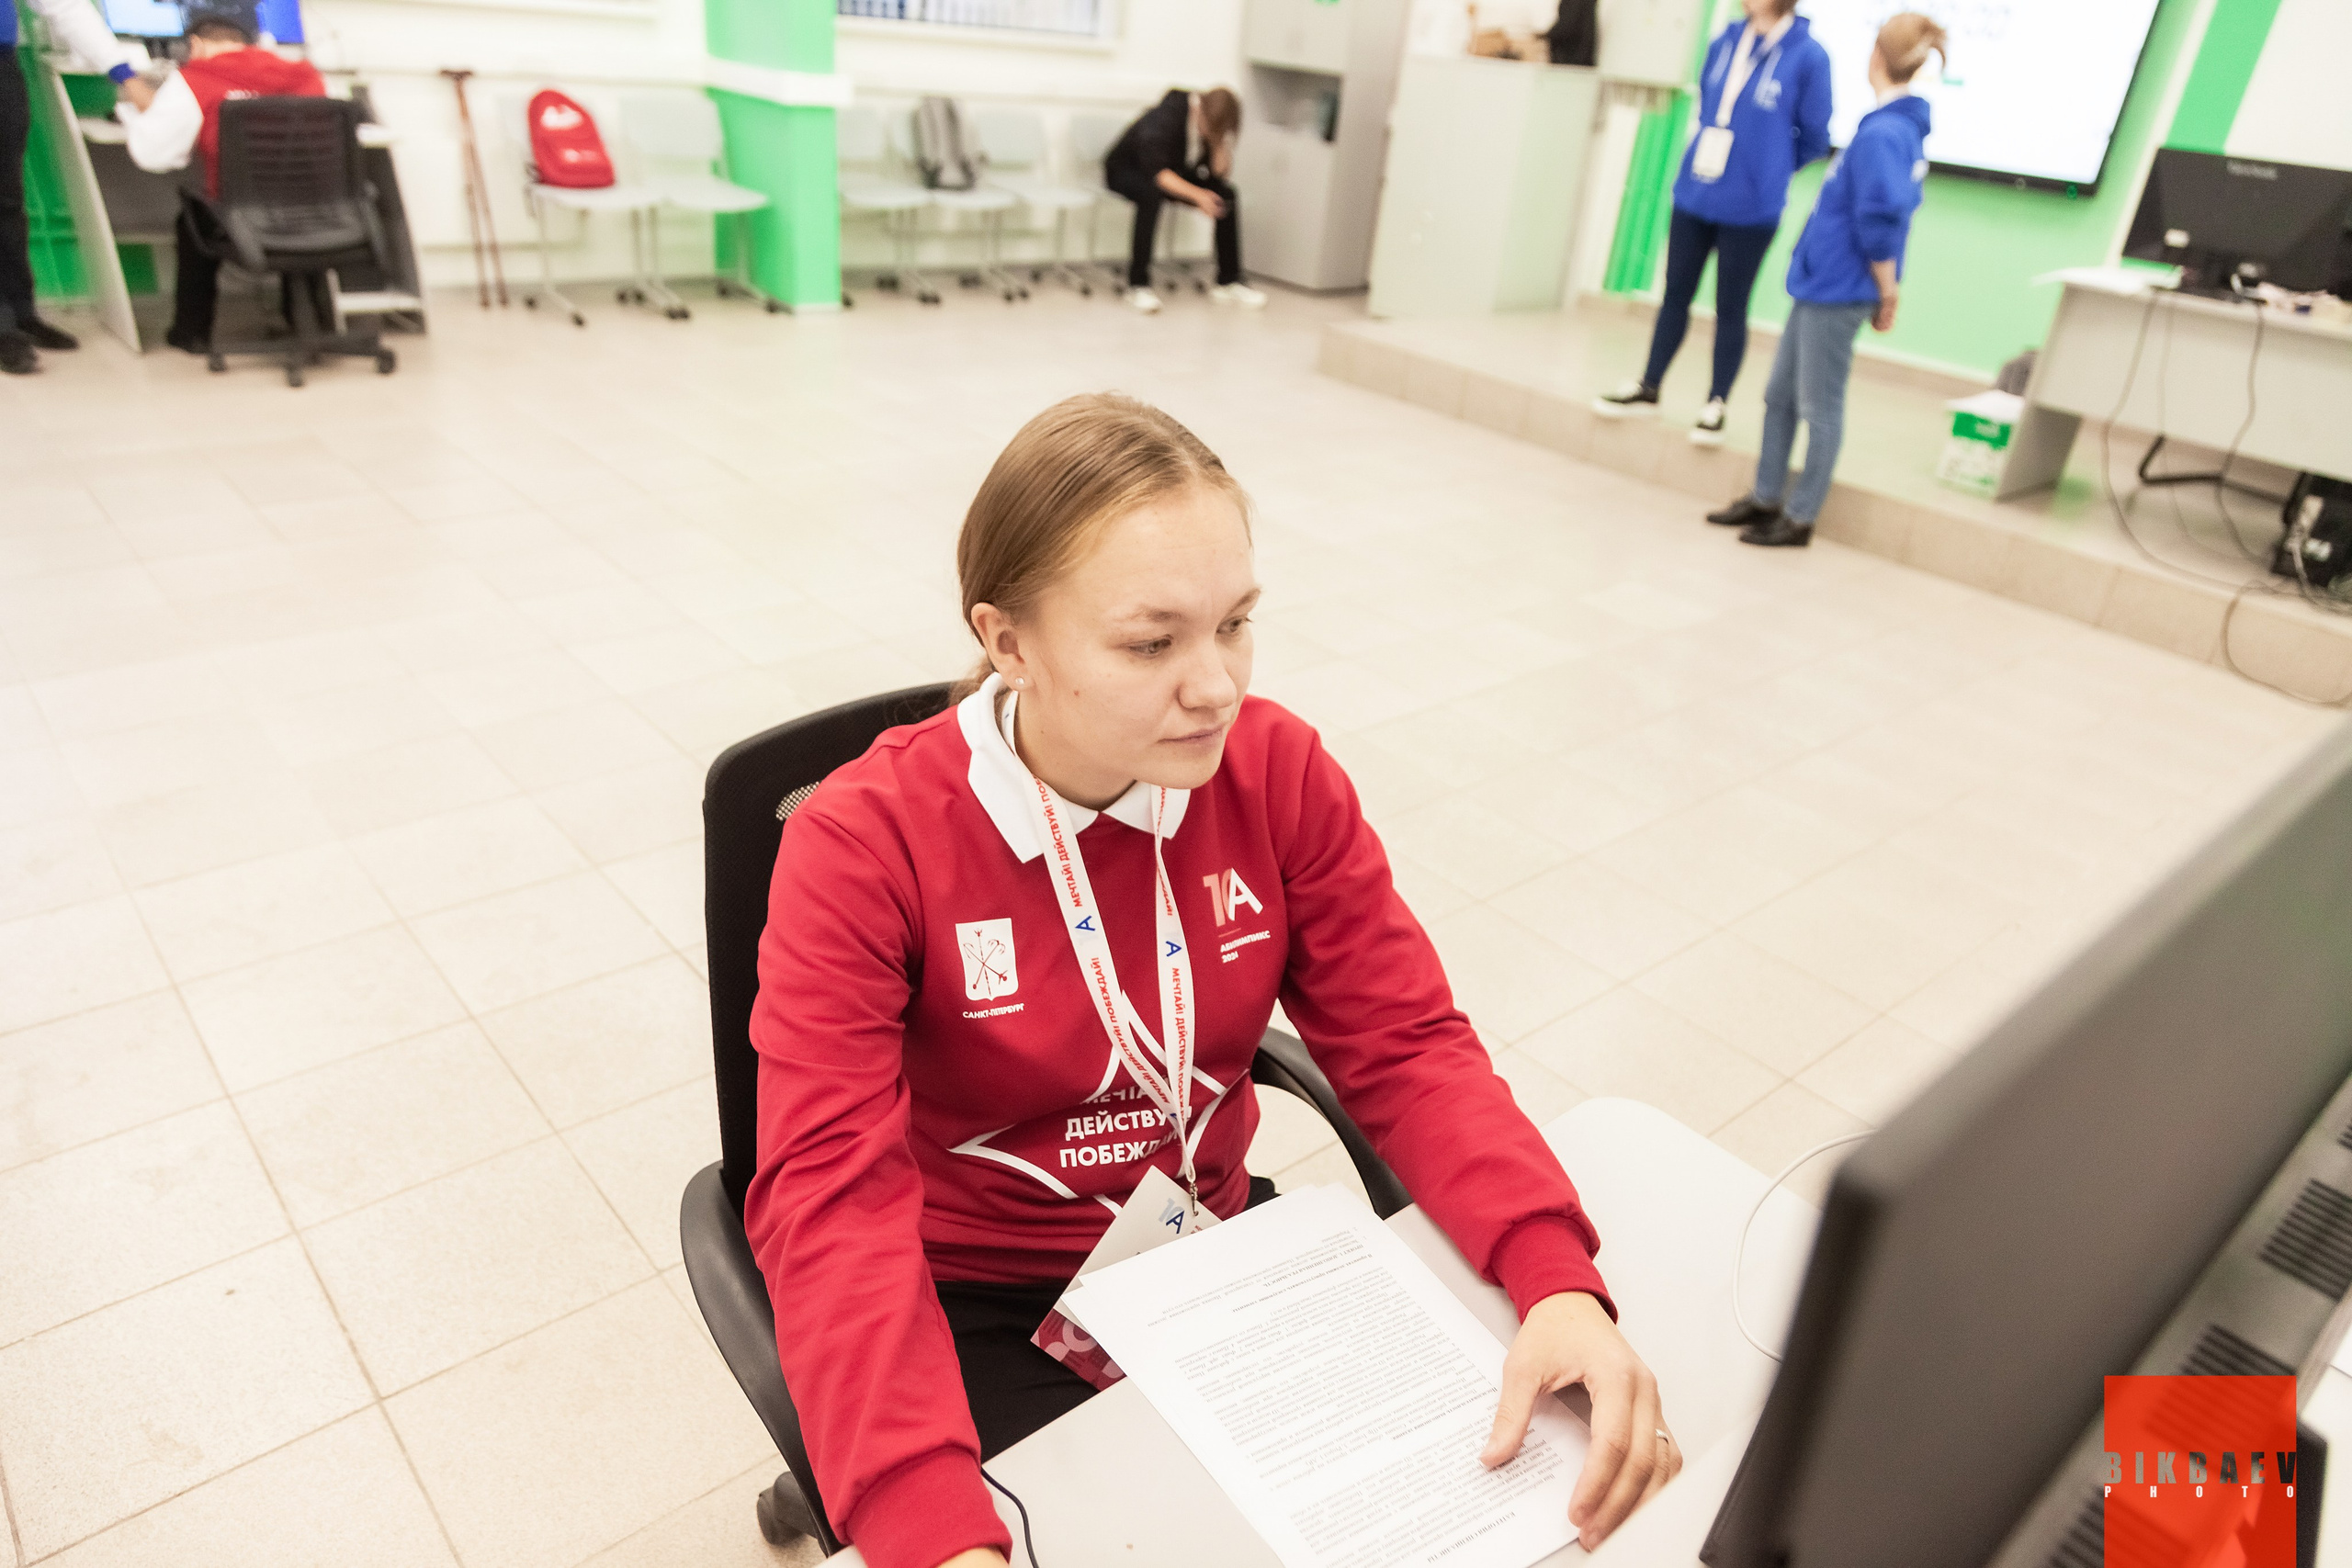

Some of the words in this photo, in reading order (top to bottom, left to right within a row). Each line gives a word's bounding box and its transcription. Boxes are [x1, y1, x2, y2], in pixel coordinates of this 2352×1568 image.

[1044, 806, 1071, 863] ДЕЙСТВУЙ!
[1061, 864, 1083, 908] МЕЧТАЙ!
[1220, 930, 1272, 953] АБИЛИМПИКС
[1091, 956, 1118, 1023] ПОБЕЖДАЙ!
[1171, 967, 1186, 1014] МЕЧТАЙ!
[962, 1002, 1024, 1019] САНКТ-ПЕТЕРБУРГ
[1175, 1017, 1189, 1071] ДЕЙСТВУЙ!
[1342, 1244, 1363, 1254] ПРОЕКТ
[1476, 1510, 1515, 1535] КАТЕГОРИЯ
[1426, 1531, 1478, 1562] СПЕЦИАЛИСТЫ
